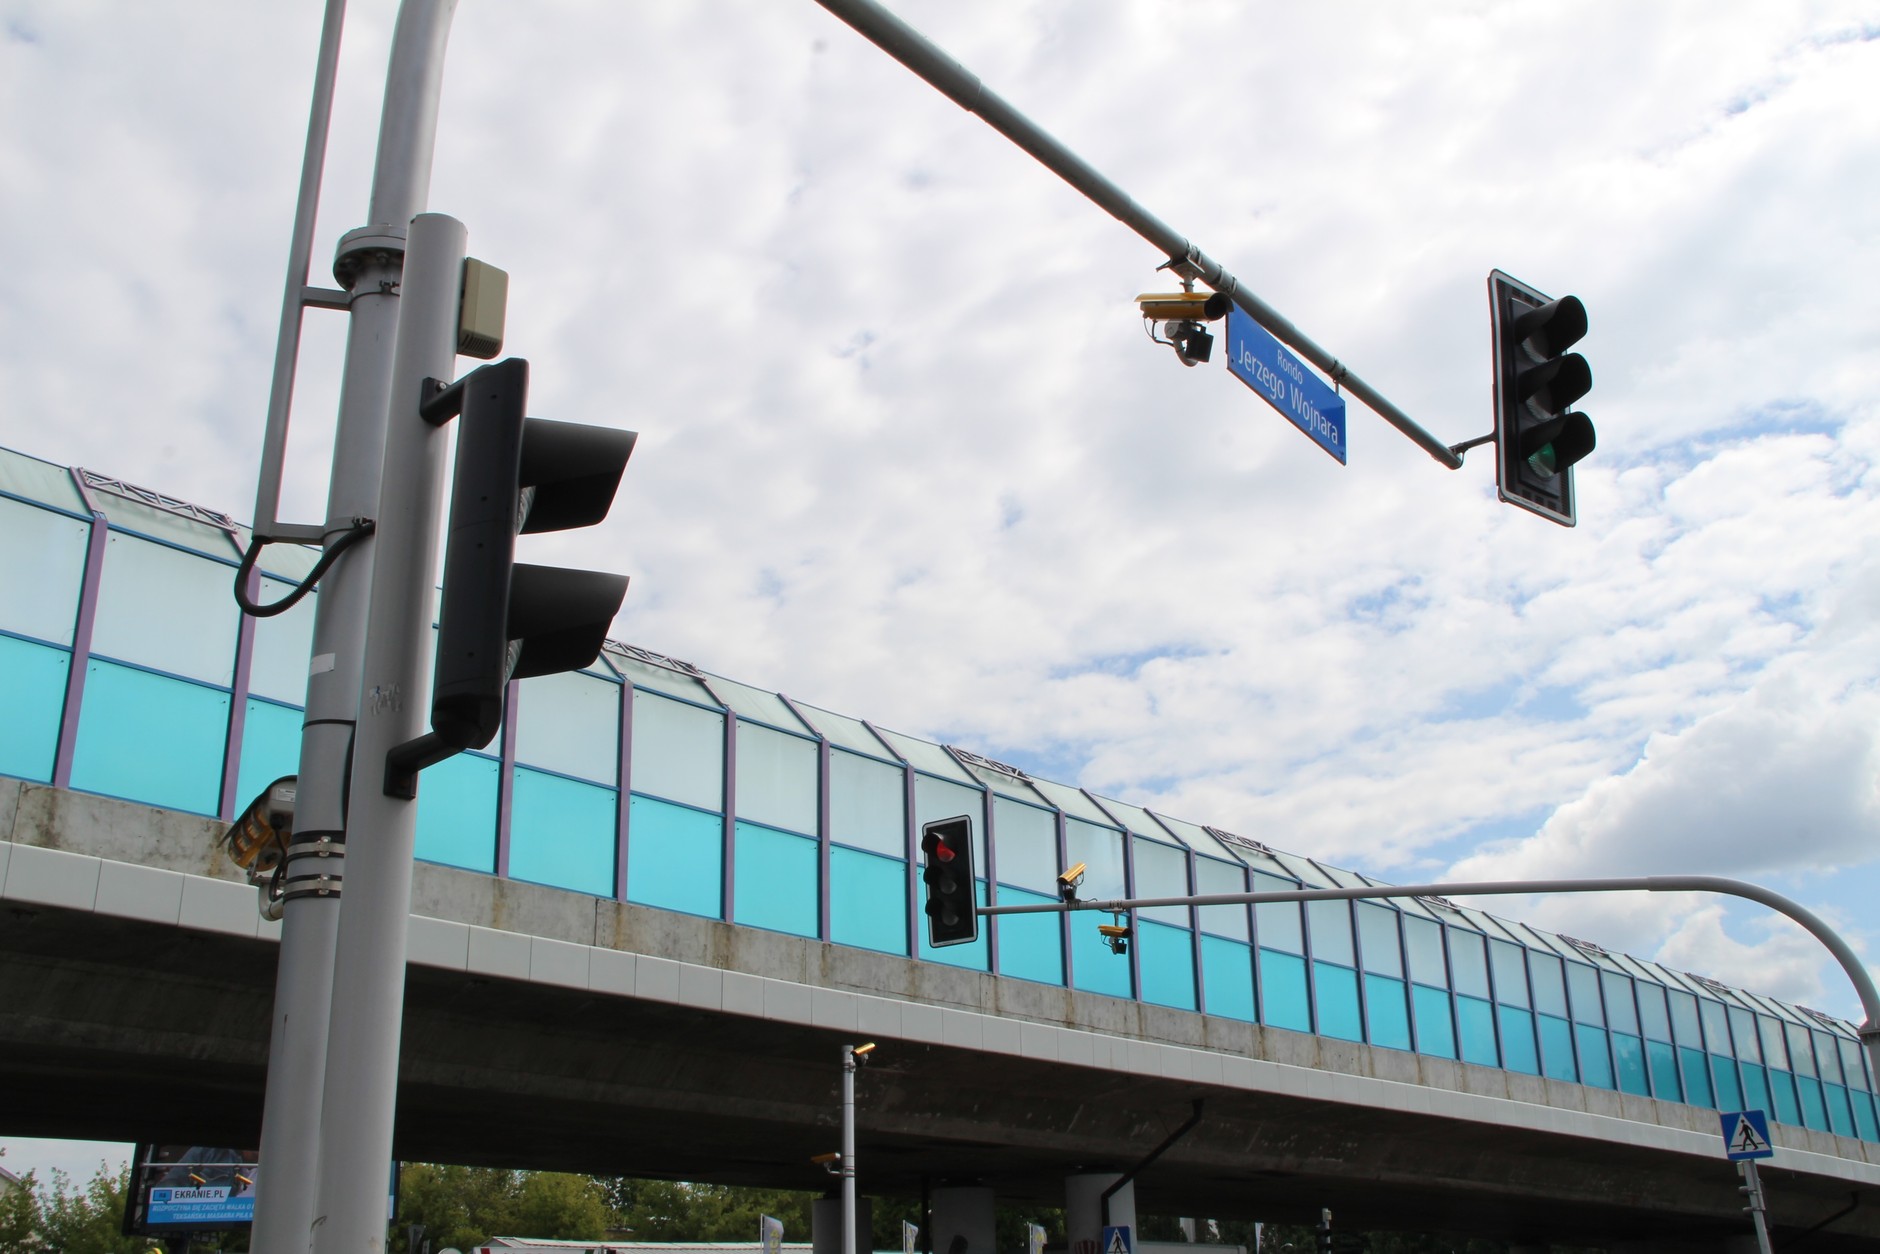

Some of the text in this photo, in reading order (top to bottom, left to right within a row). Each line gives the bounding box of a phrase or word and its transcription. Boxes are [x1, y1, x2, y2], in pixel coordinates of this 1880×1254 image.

[1277, 349, 1303, 385] Rondo
[1238, 340, 1338, 445] Jerzego Wojnara
[174, 1190, 224, 1199] EKRANIE.PL
[152, 1204, 190, 1212] ROZPOCZYNA
